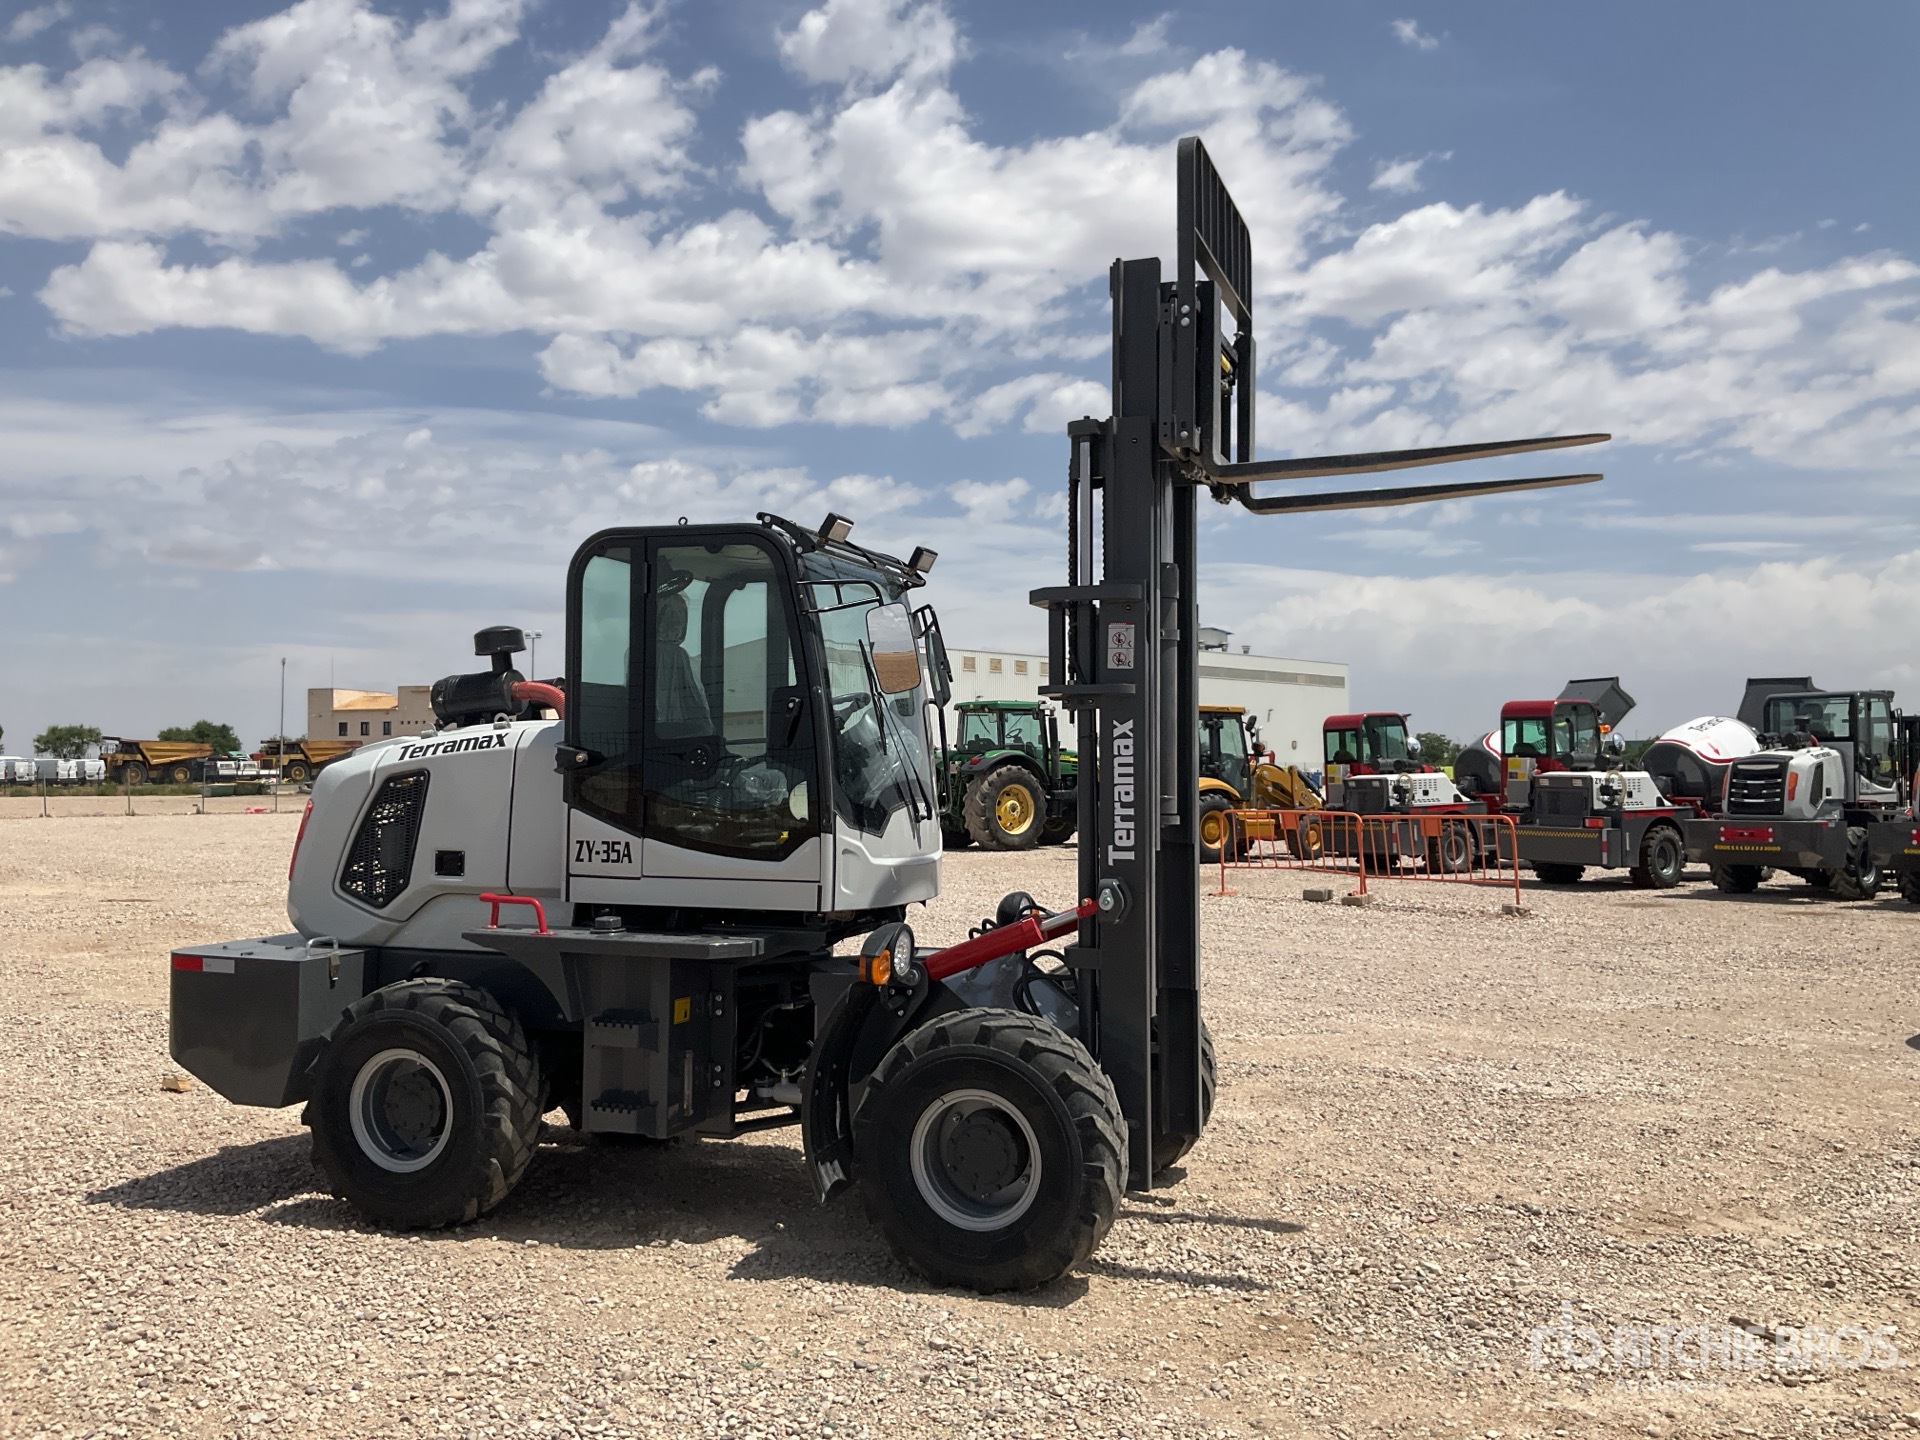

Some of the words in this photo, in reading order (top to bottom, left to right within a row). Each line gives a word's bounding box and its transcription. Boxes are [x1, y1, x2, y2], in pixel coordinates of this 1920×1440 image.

[397, 731, 510, 761] Terramax
[1107, 718, 1135, 867] Terramax
[574, 839, 633, 864] ZY-35A
